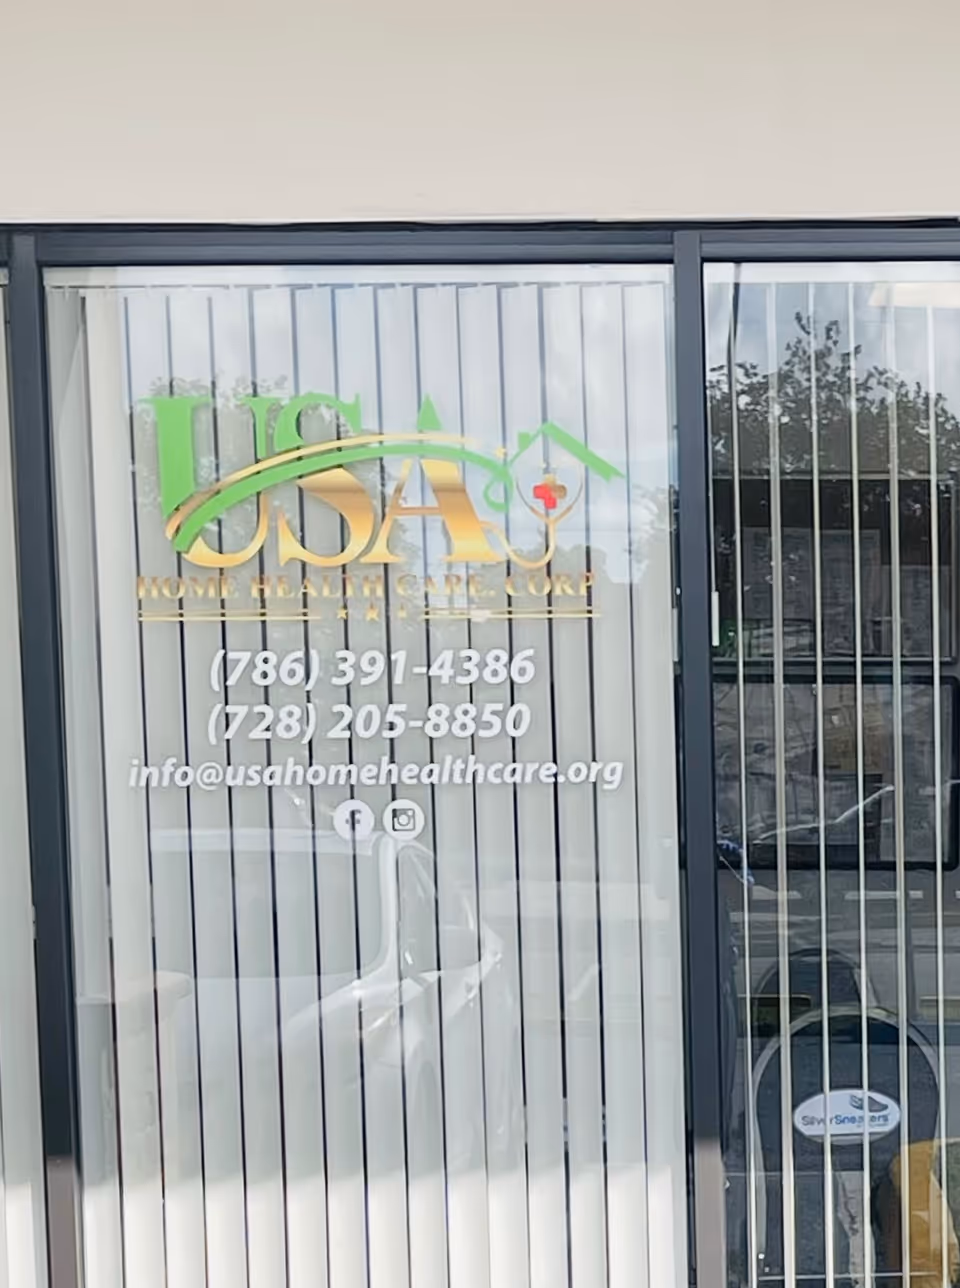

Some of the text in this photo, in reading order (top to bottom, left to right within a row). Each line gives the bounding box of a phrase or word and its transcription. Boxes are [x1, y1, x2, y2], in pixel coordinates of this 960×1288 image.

[135, 393, 502, 568] USA
[137, 574, 241, 599] HOME
[250, 572, 384, 599] HEALTH
[505, 572, 595, 597] CORP
[209, 648, 536, 692] (786) 391-4386
[206, 702, 532, 745] (728) 205-8850
[128, 754, 624, 791] info@usahomehealthcare.org
